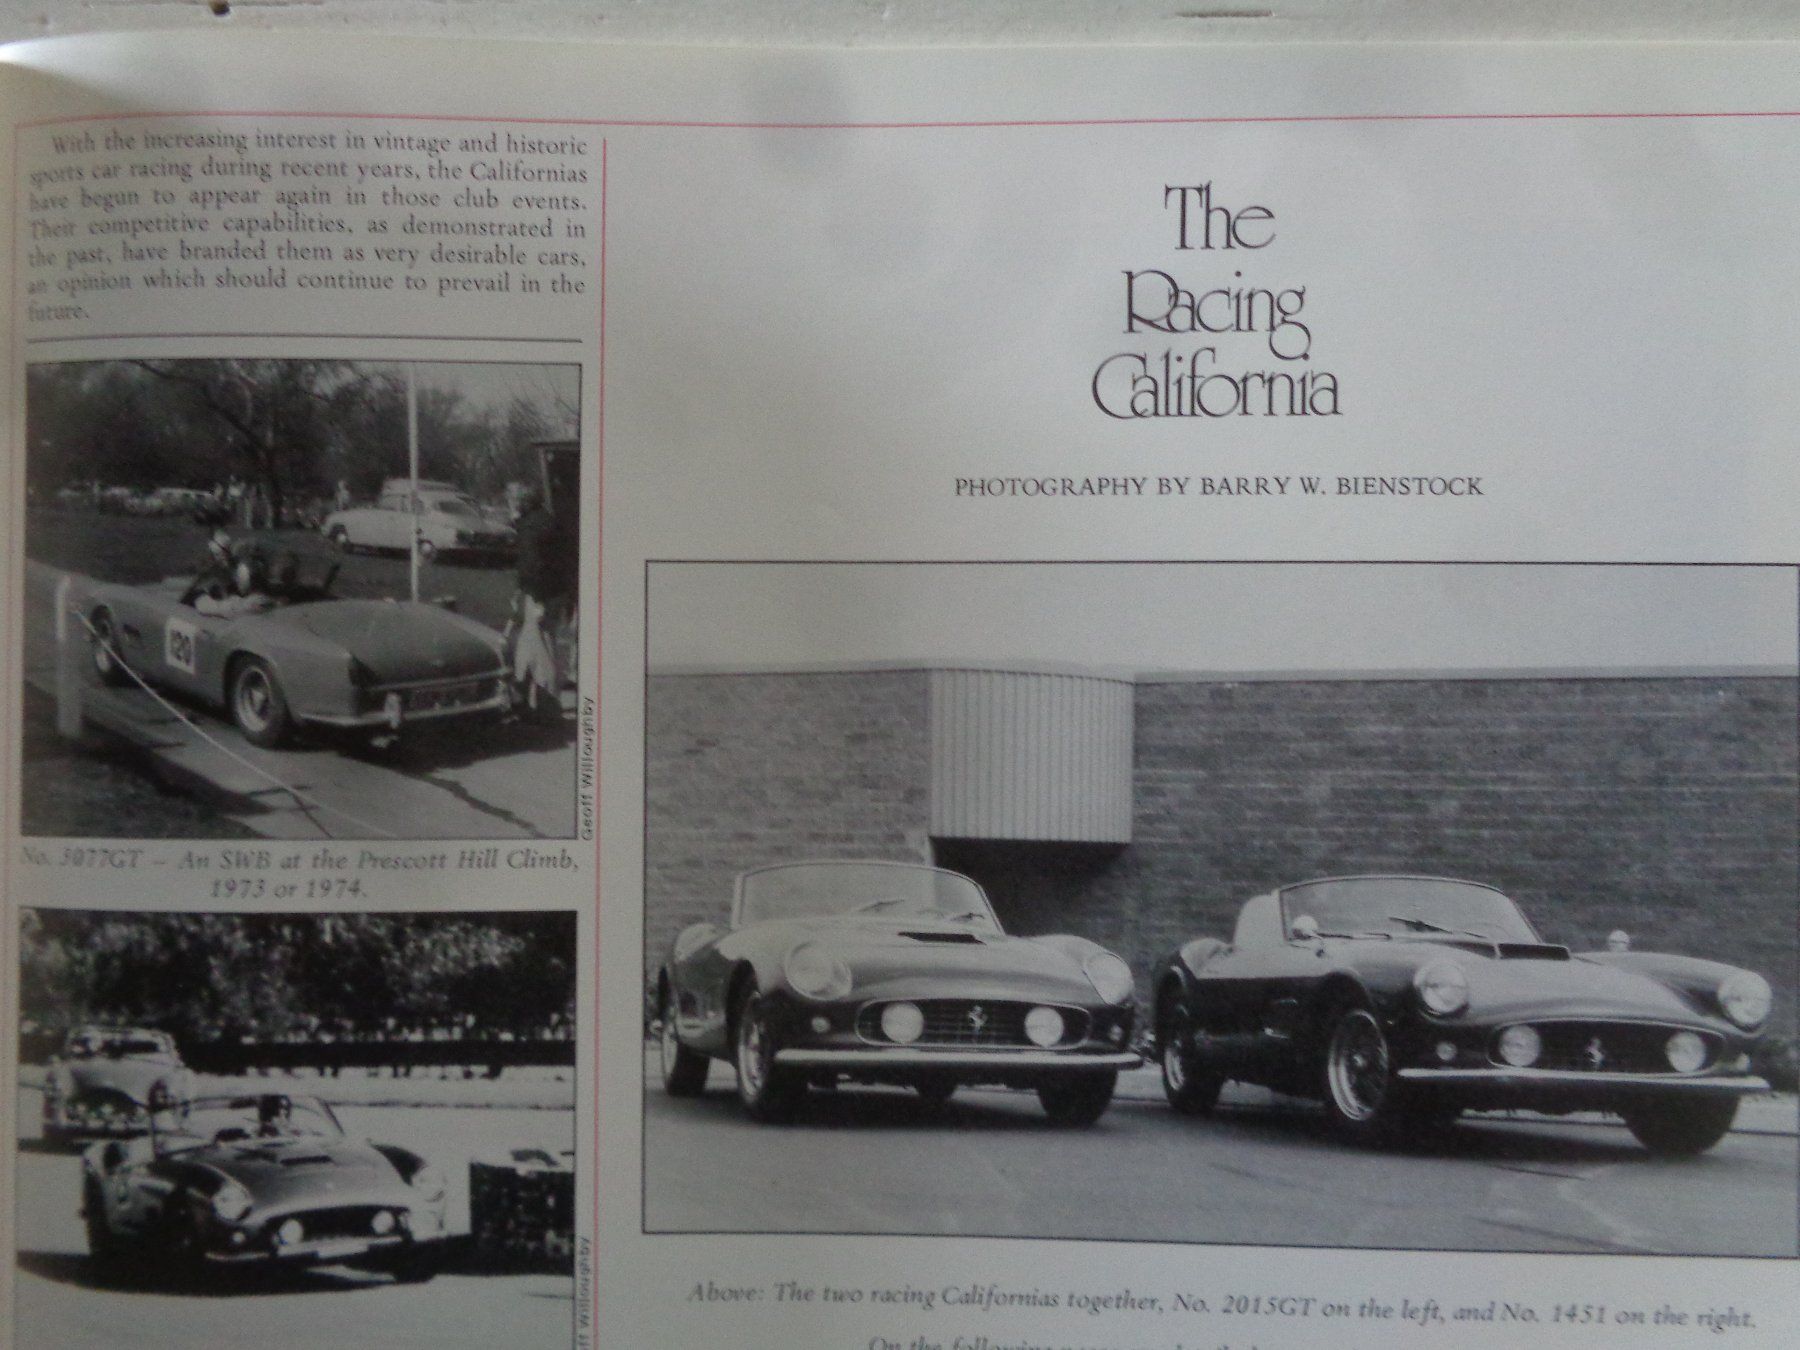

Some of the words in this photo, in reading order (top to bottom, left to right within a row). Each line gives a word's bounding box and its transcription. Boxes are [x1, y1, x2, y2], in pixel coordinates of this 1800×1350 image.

[52, 131, 96, 154] With
[104, 129, 136, 150] the
[143, 129, 248, 154] increasing
[256, 130, 336, 149] interest
[345, 130, 366, 149] in
[373, 131, 451, 157] vintage
[459, 133, 498, 152] and
[507, 133, 587, 155] historic
[91, 164, 121, 180] car
[130, 158, 192, 183] racing
[201, 155, 272, 182] during
[281, 156, 349, 177] recent
[357, 161, 421, 184] years,
[428, 159, 463, 180] the
[470, 161, 588, 183] Californias
[80, 188, 140, 213] begun
[153, 189, 176, 205] to
[189, 188, 260, 211] appear
[275, 187, 331, 211] again
[346, 187, 367, 205] in
[381, 186, 441, 207] those
[453, 188, 500, 208] club
[29, 219, 76, 241] Their
[88, 212, 210, 239] competitive
[367, 220, 388, 233] as
[402, 215, 552, 237] demonstrated
[566, 218, 586, 238] in
[1164, 181, 1276, 250] The
[28, 245, 56, 268] the
[66, 249, 112, 270] past,
[122, 241, 169, 261] have
[180, 239, 267, 260] branded
[276, 240, 333, 261] them
[343, 248, 365, 262] as
[375, 248, 419, 269] very
[430, 243, 528, 265] desirable
[538, 253, 586, 267] cars,
[26, 279, 48, 295] an
[57, 274, 132, 298] opinion
[144, 268, 206, 289] which
[216, 267, 288, 289] should
[297, 270, 394, 290] continue
[404, 275, 427, 291] to
[438, 272, 511, 297] prevail
[521, 273, 541, 293] in
[551, 273, 586, 295] the
[1122, 269, 1312, 360] Racing
[1092, 346, 1342, 419] California
[955, 477, 1147, 497] PHOTOGRAPHY
[1157, 477, 1190, 496] BY
[1201, 476, 1291, 496] BARRY
[1300, 477, 1327, 496] W.
[1336, 476, 1486, 496] BIENSTOCK
[580, 696, 595, 789] Willoughby
[580, 794, 594, 841] Geoff
[178, 851, 209, 869] An
[219, 849, 270, 869] SWB
[280, 854, 302, 869] at
[311, 850, 348, 869] the
[357, 850, 447, 869] Prescott
[458, 849, 500, 869] Hill
[506, 849, 579, 872] Climb,
[209, 879, 266, 898] 1973
[273, 884, 298, 898] or
[306, 879, 367, 898] 1974.
[688, 1281, 765, 1303] Above:
[774, 1281, 816, 1303] The
[823, 1286, 864, 1303] two
[870, 1285, 936, 1311] racing
[941, 1285, 1060, 1311] Californias
[1067, 1289, 1164, 1315] together,
[1172, 1292, 1211, 1313] No.
[1222, 1295, 1317, 1317] 2015GT
[1321, 1302, 1352, 1317] on
[1357, 1298, 1395, 1319] the
[1401, 1299, 1446, 1326] left,
[1452, 1301, 1496, 1321] and
[1501, 1301, 1540, 1322] No.
[1551, 1304, 1606, 1324] 1451
[1614, 1310, 1645, 1324] on
[1652, 1305, 1690, 1326] the
[1696, 1307, 1756, 1334] right.
